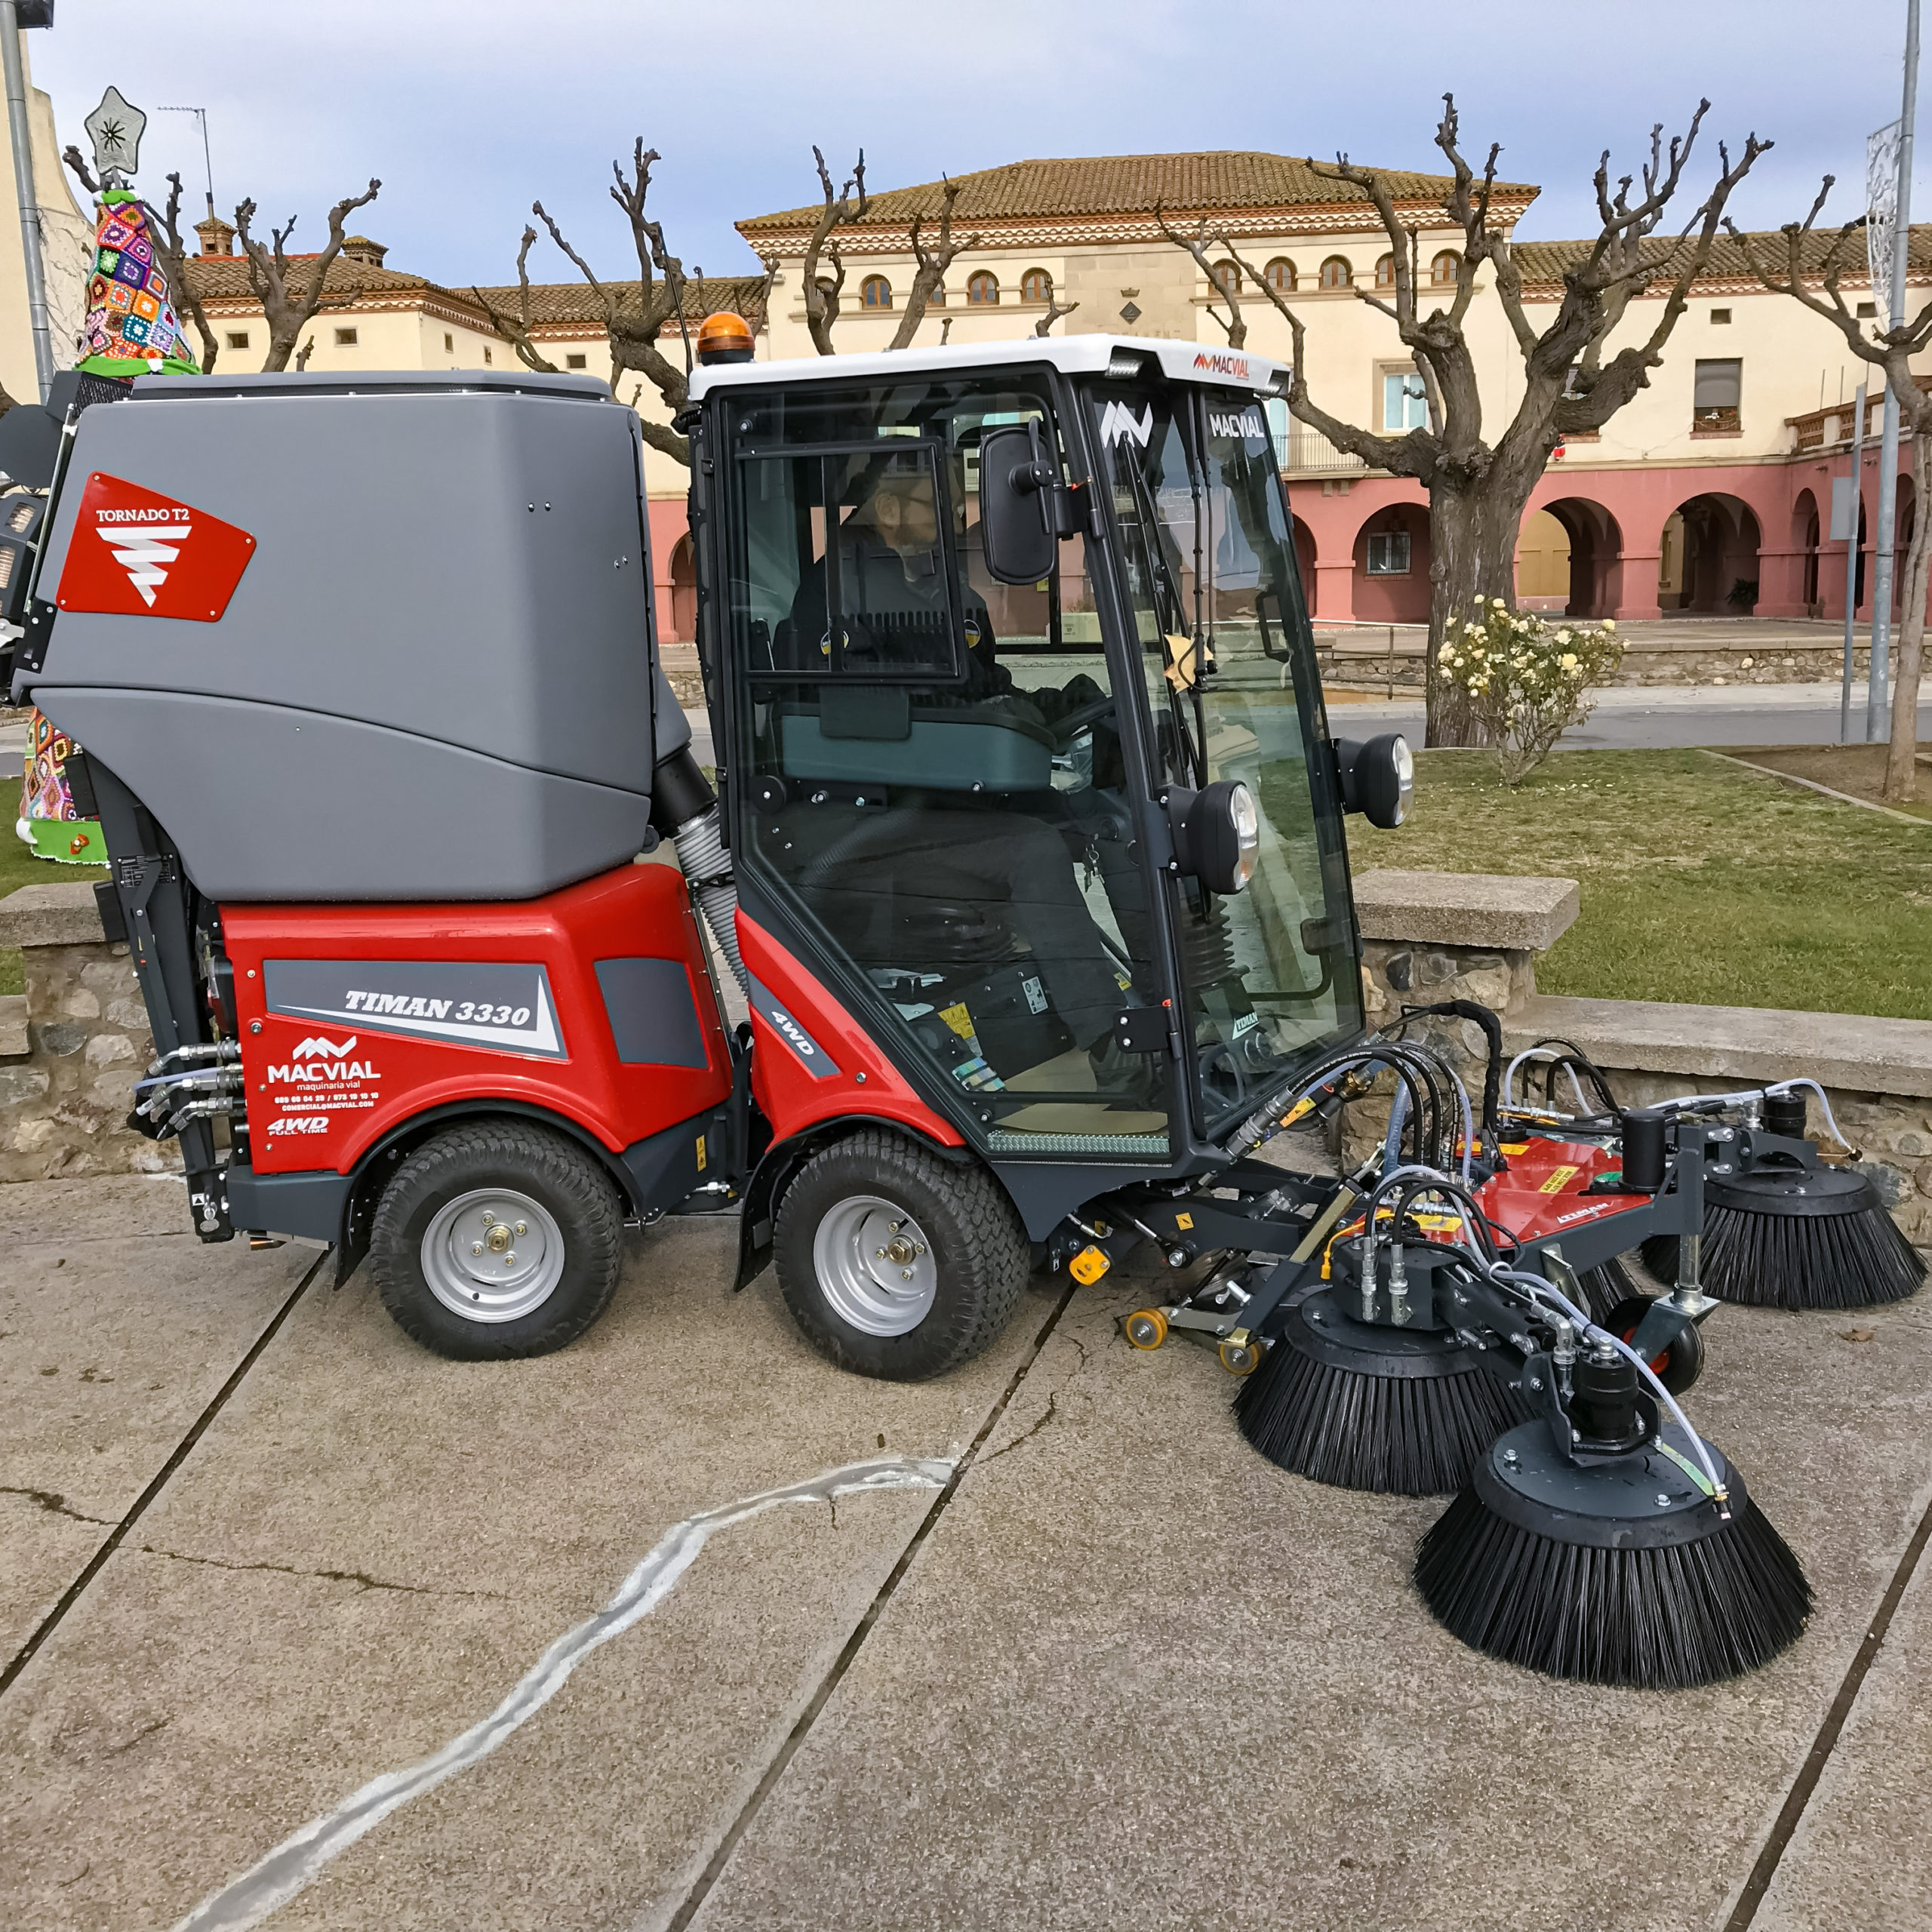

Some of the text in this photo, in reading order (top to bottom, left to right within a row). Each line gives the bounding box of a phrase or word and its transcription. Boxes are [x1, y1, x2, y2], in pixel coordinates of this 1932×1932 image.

[1213, 355, 1249, 377] MACVIAL
[1209, 414, 1265, 438] MACVIAL
[96, 508, 190, 522] TORNADO T2
[345, 990, 531, 1026] TIMAN 3330
[771, 1011, 814, 1055] 4WD
[267, 1060, 381, 1084] MACVIAL
[297, 1080, 360, 1092] maquinaria vial
[281, 1100, 374, 1112] COMERCIAL@MACVIAL.COM
[266, 1116, 329, 1131] 4WD
